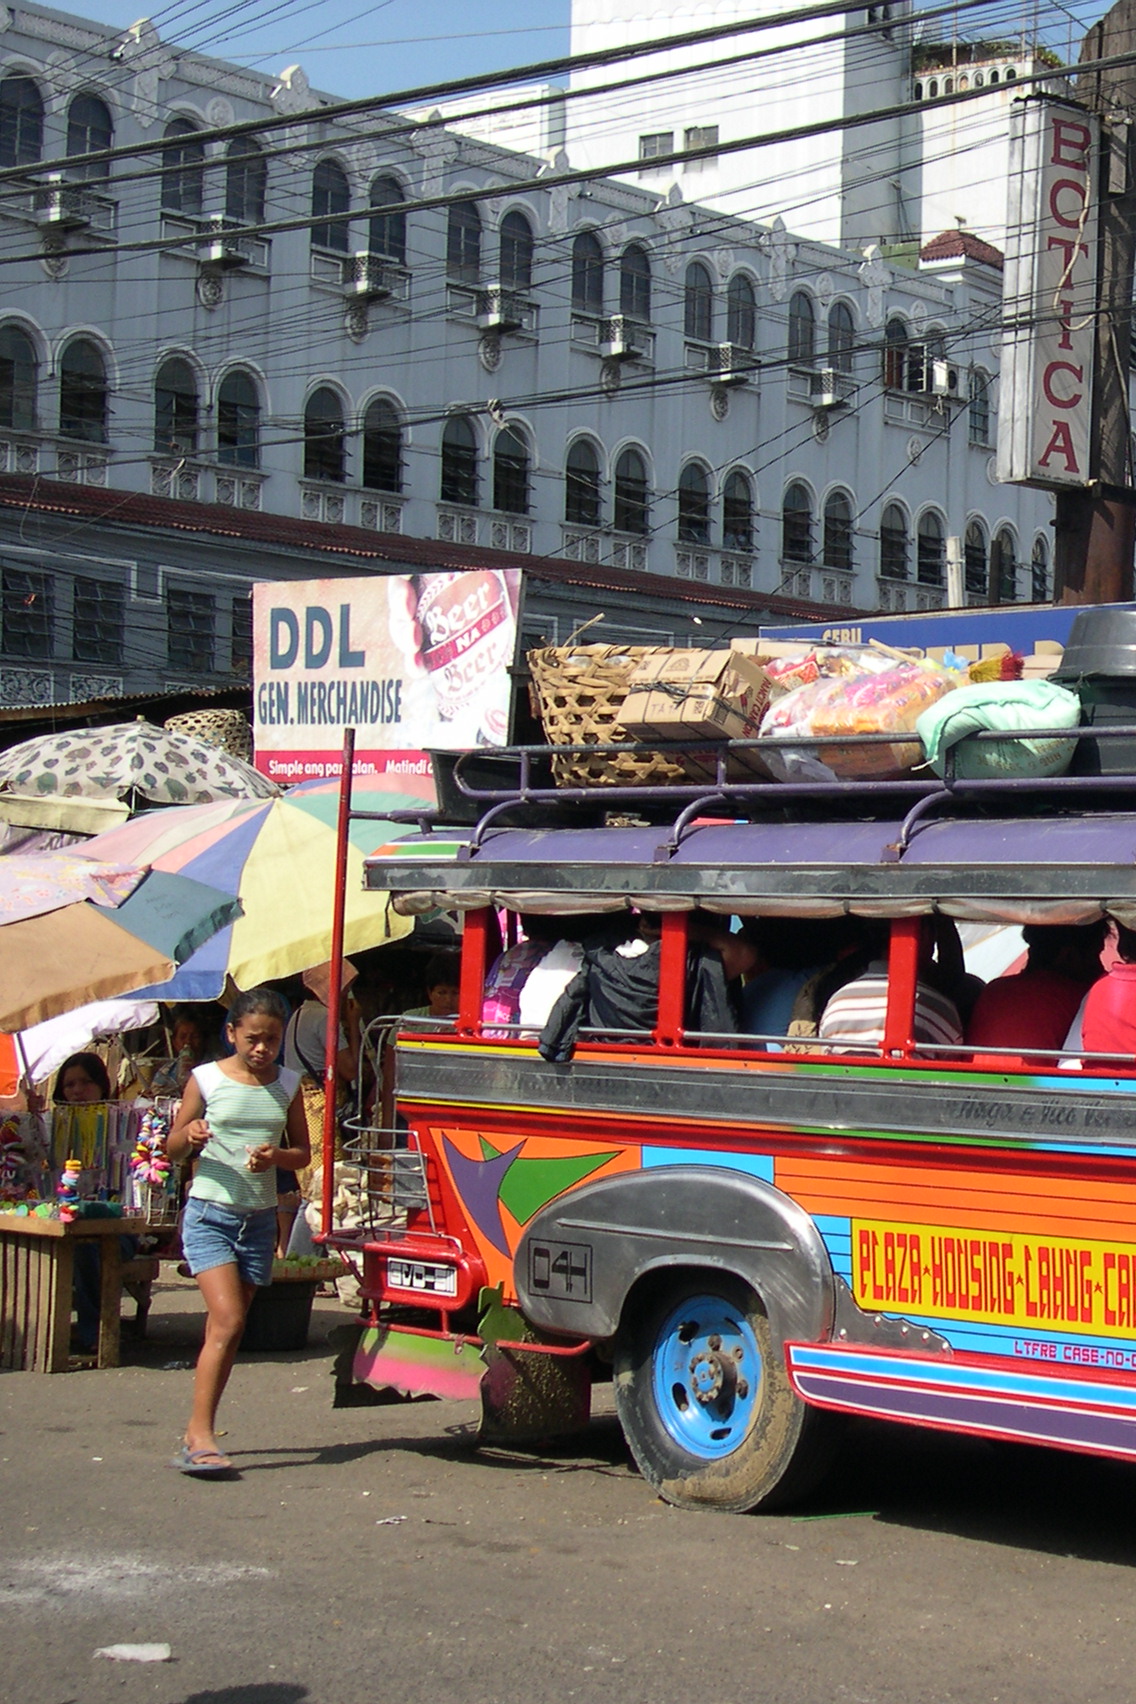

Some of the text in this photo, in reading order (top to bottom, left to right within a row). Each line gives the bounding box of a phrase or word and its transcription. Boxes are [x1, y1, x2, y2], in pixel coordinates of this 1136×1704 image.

[1038, 117, 1092, 473] BOTICA
[270, 603, 365, 670] DDL
[425, 581, 490, 647] Beer
[258, 679, 402, 725] GEN. MERCHANDISE
[269, 760, 303, 777] Simple
[304, 762, 323, 777] ang
[386, 759, 427, 774] Matindi
[859, 1229, 922, 1304] PLAZA
[930, 1235, 1015, 1314] HOUSING
[1024, 1244, 1093, 1324] LAHUG
